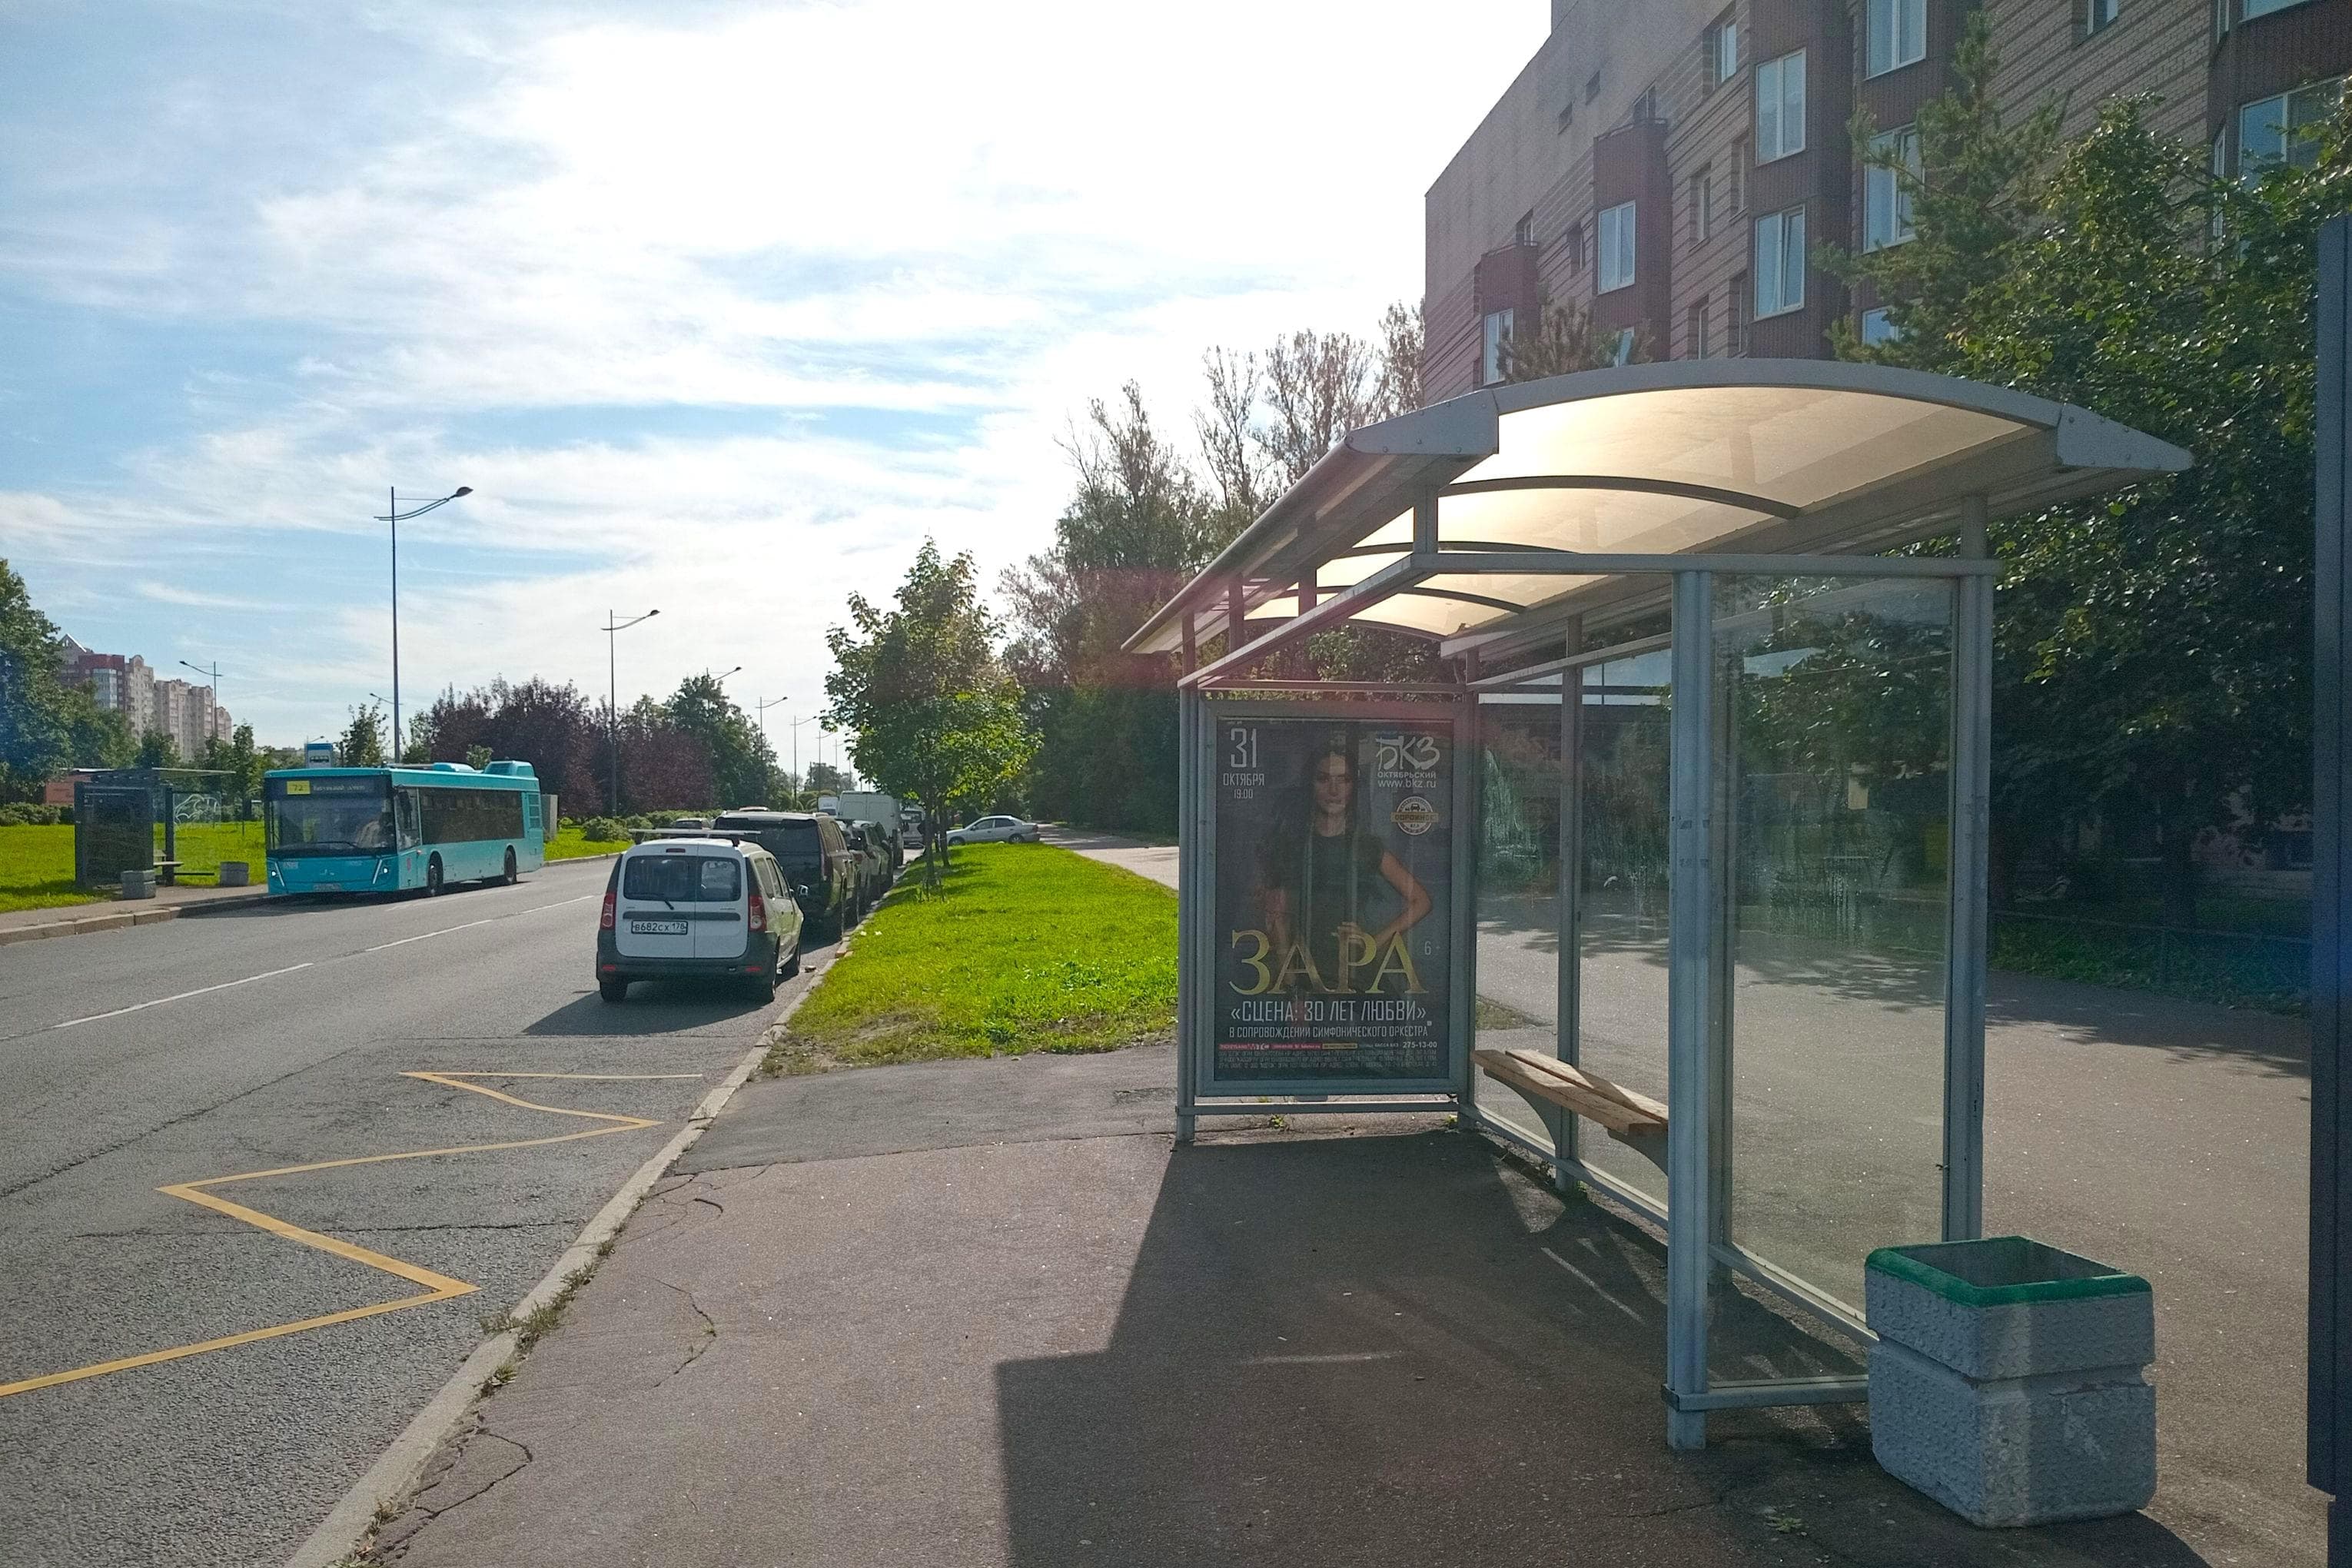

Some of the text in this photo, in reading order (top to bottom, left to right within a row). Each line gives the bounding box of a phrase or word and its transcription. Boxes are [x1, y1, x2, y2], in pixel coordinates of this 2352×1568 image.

[1231, 728, 1257, 768] 31
[1223, 772, 1264, 786] ОКТЯБРЯ
[1377, 779, 1437, 788] www.bkz.ru
[1229, 929, 1429, 995] ЗАРА
[1231, 1000, 1427, 1022] «СЦЕНА: 30 ЛЕТ ЛЮБВИ»
[1229, 1025, 1428, 1039] В СОПРОВОЖДЕНИИ СИМФОНИЧЕСКОГО ОРКЕСТРА
